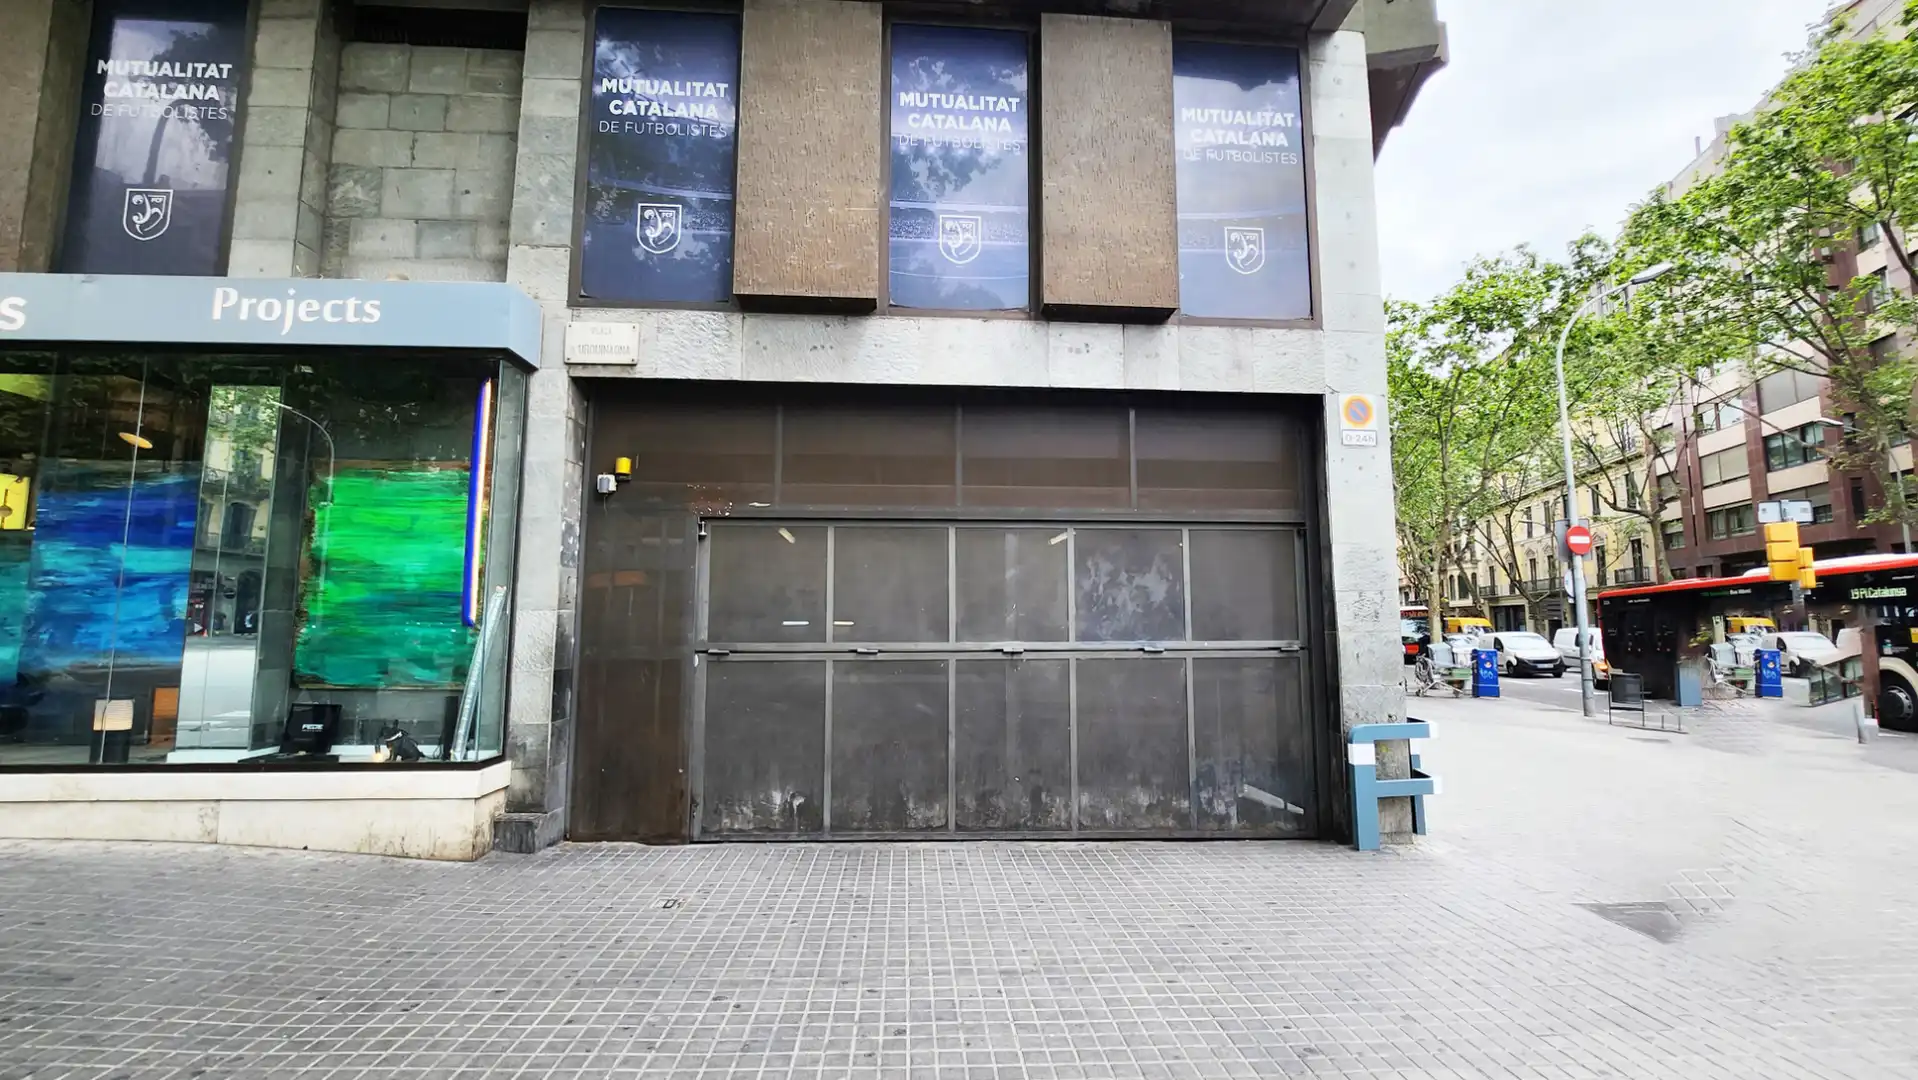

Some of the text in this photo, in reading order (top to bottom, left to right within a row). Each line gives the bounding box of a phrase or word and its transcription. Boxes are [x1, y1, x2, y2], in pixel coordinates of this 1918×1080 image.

[97, 59, 232, 79] MUTUALITAT
[104, 81, 220, 101] CATALANA
[601, 77, 728, 98] MUTUALITAT
[91, 103, 228, 120] DE FUTBOLISTES
[609, 99, 719, 118] CATALANA
[899, 91, 1020, 113] MUTUALITAT
[908, 113, 1012, 133] CATALANA
[1181, 107, 1295, 127] MUTUALITAT
[599, 120, 728, 138] DE FUTBOLISTES
[1190, 128, 1289, 147] CATALANA
[899, 134, 1021, 151] DE FUTBOLISTES
[1183, 148, 1298, 165] DE FUTBOLISTES
[212, 287, 381, 336] Projects
